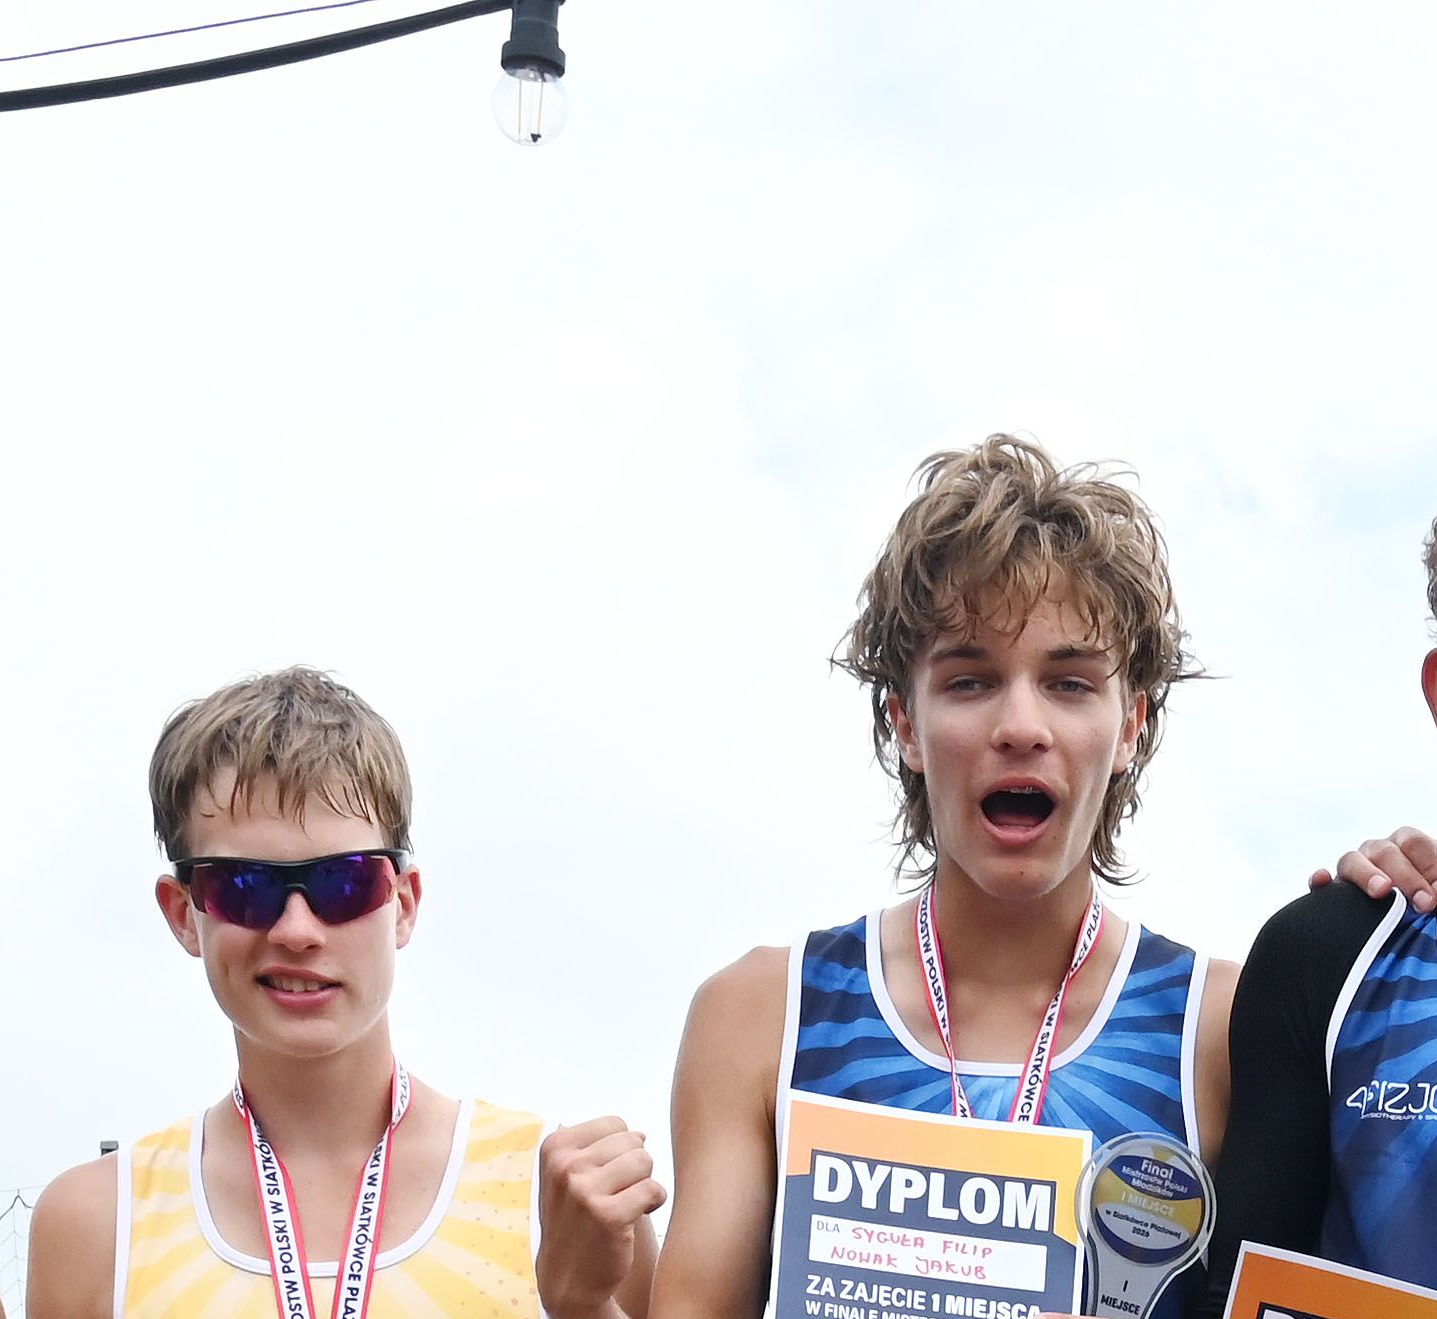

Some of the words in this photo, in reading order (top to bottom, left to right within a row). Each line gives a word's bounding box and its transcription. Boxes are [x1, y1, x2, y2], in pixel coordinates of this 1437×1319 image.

[1017, 1030, 1050, 1123] SIATKÓWCE
[1140, 1158, 1174, 1179] Final
[811, 1153, 1051, 1233] DYPLOM
[347, 1191, 377, 1282] SIATKÓWCE
[816, 1220, 840, 1233] DLA
[271, 1216, 296, 1275] POLSKI
[830, 1245, 897, 1267] NOWAK
[914, 1255, 987, 1281] JAKUB
[942, 1239, 992, 1259] FILIP
[805, 1274, 836, 1297] ZA
[839, 1279, 926, 1312] ZAJĘCIE
[931, 1292, 940, 1312] 1
[805, 1300, 821, 1316] W
[1100, 1293, 1141, 1316] MIEJSCE
